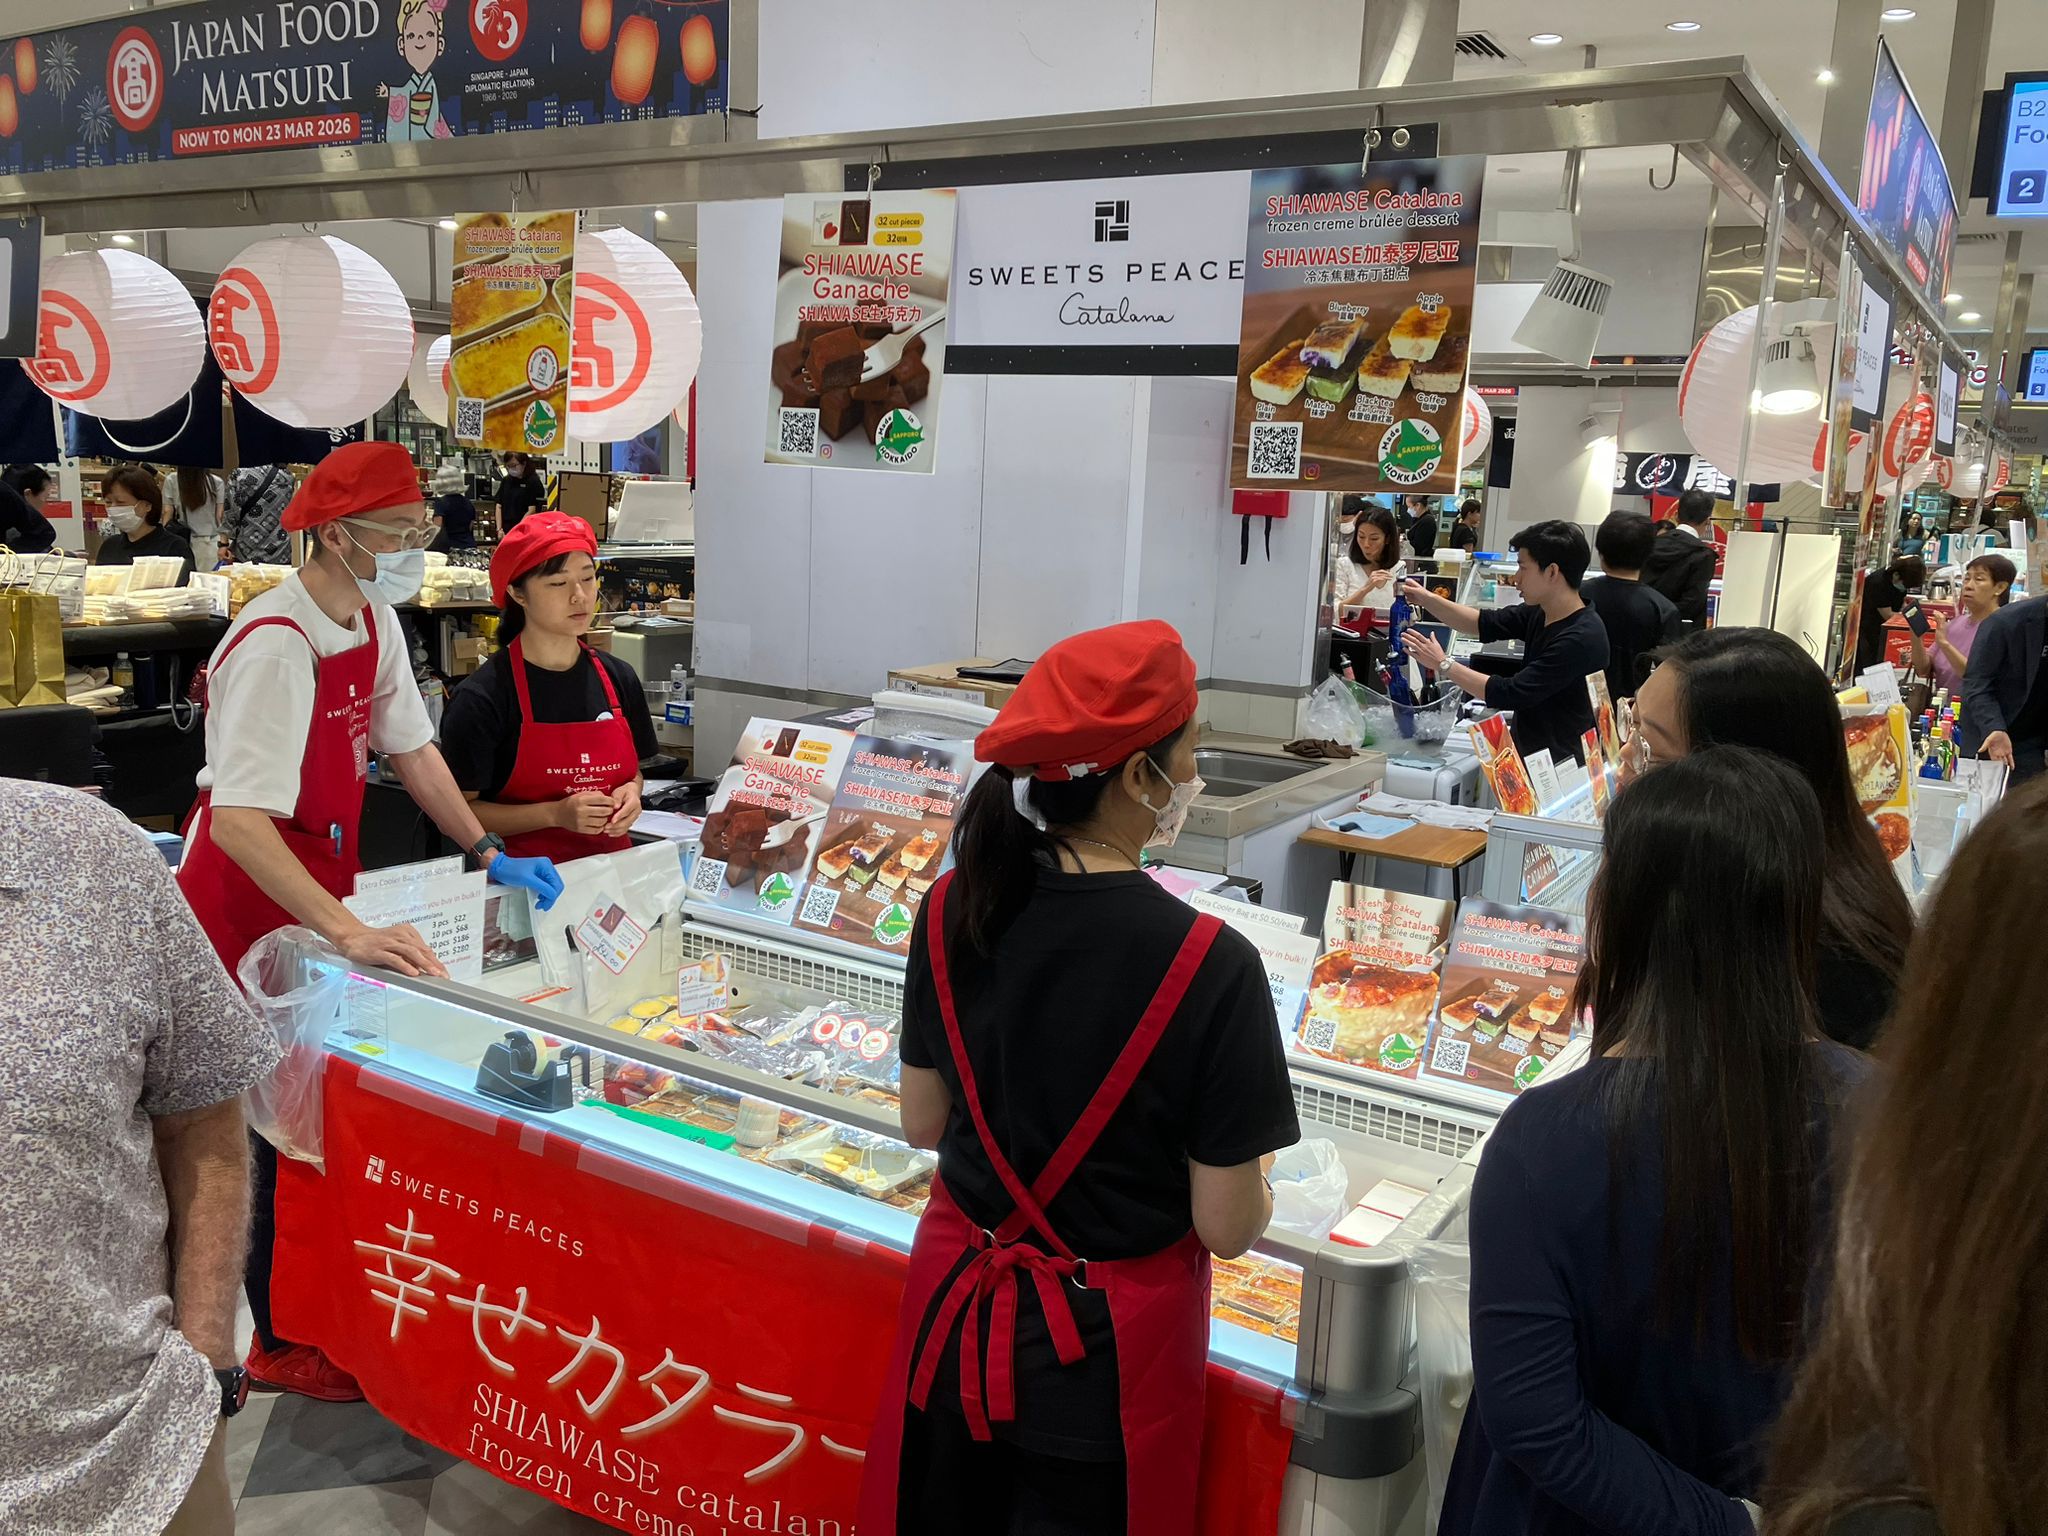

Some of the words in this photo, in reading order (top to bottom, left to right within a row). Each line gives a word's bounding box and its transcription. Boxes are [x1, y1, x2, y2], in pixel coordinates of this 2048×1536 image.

[171, 13, 264, 76] JAPAN
[275, 0, 380, 49] FOOD
[470, 70, 504, 82] SINGAPORE
[509, 67, 529, 78] JAPAN
[200, 61, 353, 115] MATSURI
[464, 82, 501, 93] DIPLOMATIC
[501, 78, 535, 90] RELATIONS
[502, 91, 518, 100] 2026
[179, 131, 209, 149] NOW
[213, 129, 230, 146] TO
[232, 125, 263, 145] MON
[265, 124, 281, 140] 23
[284, 121, 314, 139] MAR
[317, 117, 352, 137] 2026
[2014, 124, 2048, 144] Fo
[2018, 177, 2035, 197] 2
[1266, 190, 1370, 217] SHIAWASE
[1374, 187, 1463, 210] Catalana
[877, 216, 888, 226] 32
[889, 218, 899, 226] cut
[900, 217, 920, 229] pieces
[1267, 218, 1309, 234] frozen
[1313, 218, 1354, 232] creme
[1358, 213, 1403, 230] brûlée
[1407, 211, 1459, 227] dessert
[465, 227, 516, 242] SHIAWASE
[519, 227, 563, 242] Catalana
[535, 244, 560, 254] dessert
[1262, 240, 1460, 268] SHIAWASE加泰罗尼亚
[803, 252, 923, 276] SHIAWASE
[968, 264, 1104, 286] SWEETS
[813, 276, 910, 299] Ganache
[1417, 293, 1443, 304] Apple
[798, 305, 922, 323] SHIAWASE生巧克力
[1059, 292, 1175, 326] Catalana
[1328, 302, 1369, 317] Blueberry
[1416, 392, 1447, 406] Coffee
[2034, 385, 2042, 394] 3
[1256, 402, 1276, 414] Plain
[1304, 398, 1335, 412] Matcha
[1356, 393, 1379, 407] Black
[1380, 398, 1395, 408] tea
[1381, 427, 1400, 450] Made
[1421, 426, 1431, 436] in
[879, 445, 918, 464] HOKKAIDO
[1401, 445, 1437, 455] SAPPORO
[1382, 462, 1435, 483] HOKKAIDO
[546, 767, 586, 775] SWEETS
[590, 763, 621, 773] PEACES
[742, 757, 826, 785] SHIAWASE
[853, 750, 912, 774] SHIAWASE
[744, 773, 810, 799] Ganache
[360, 881, 378, 890] Extra
[1193, 896, 1211, 908] Extra
[1212, 901, 1236, 914] Cooler
[1236, 908, 1251, 920] Bag
[1250, 912, 1258, 920] at
[1258, 913, 1299, 931] $0.50/each
[1357, 898, 1392, 912] Freshly
[1393, 901, 1422, 918] baked
[432, 921, 437, 929] 3
[438, 920, 449, 928] pcs
[454, 914, 466, 924] $22
[1335, 905, 1392, 927] SHIAWASE
[1393, 914, 1440, 935] Catalana
[1463, 913, 1529, 935] SHIAWASE
[1529, 924, 1583, 944] Catalana
[432, 931, 441, 939] 10
[441, 929, 453, 939] pcs
[455, 923, 469, 934] $68
[1408, 929, 1438, 943] dessert
[1463, 926, 1489, 938] frozen
[438, 940, 450, 949] pcs
[438, 951, 450, 959] pcs
[1260, 946, 1273, 958] buy
[1275, 950, 1283, 958] in
[1284, 952, 1307, 965] bulk!!
[1269, 972, 1285, 984] $22
[390, 1170, 479, 1215] SWEETS
[493, 1207, 584, 1257] PEACES
[466, 1423, 573, 1499] frozen
[473, 1382, 660, 1496] SHIAWASE
[676, 1484, 857, 1536] catalan
